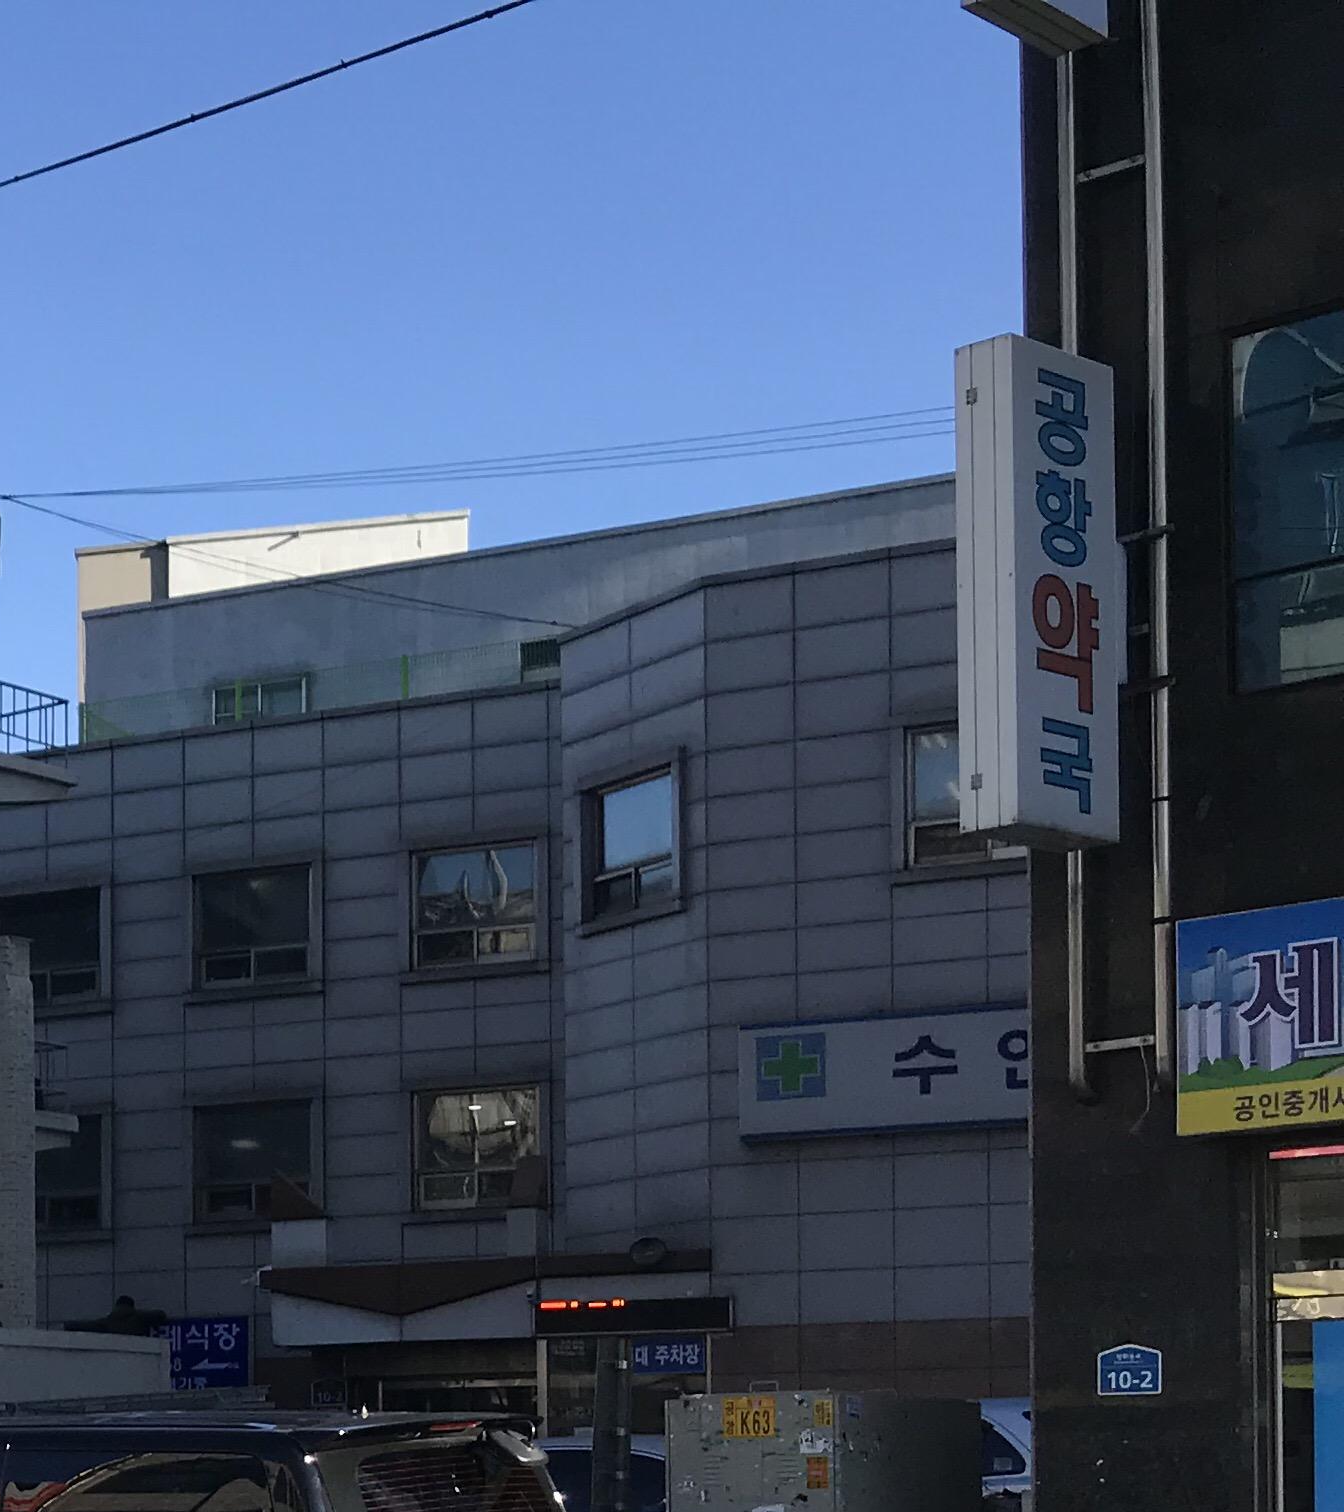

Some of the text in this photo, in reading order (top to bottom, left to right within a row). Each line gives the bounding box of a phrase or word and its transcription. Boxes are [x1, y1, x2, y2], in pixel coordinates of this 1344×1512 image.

[1032, 367, 1100, 815] 공항약국
[150, 1322, 241, 1352] 례식장
[655, 1344, 700, 1365] 주차장
[1107, 1370, 1154, 1389] 10-2
[739, 1410, 771, 1436] K63
